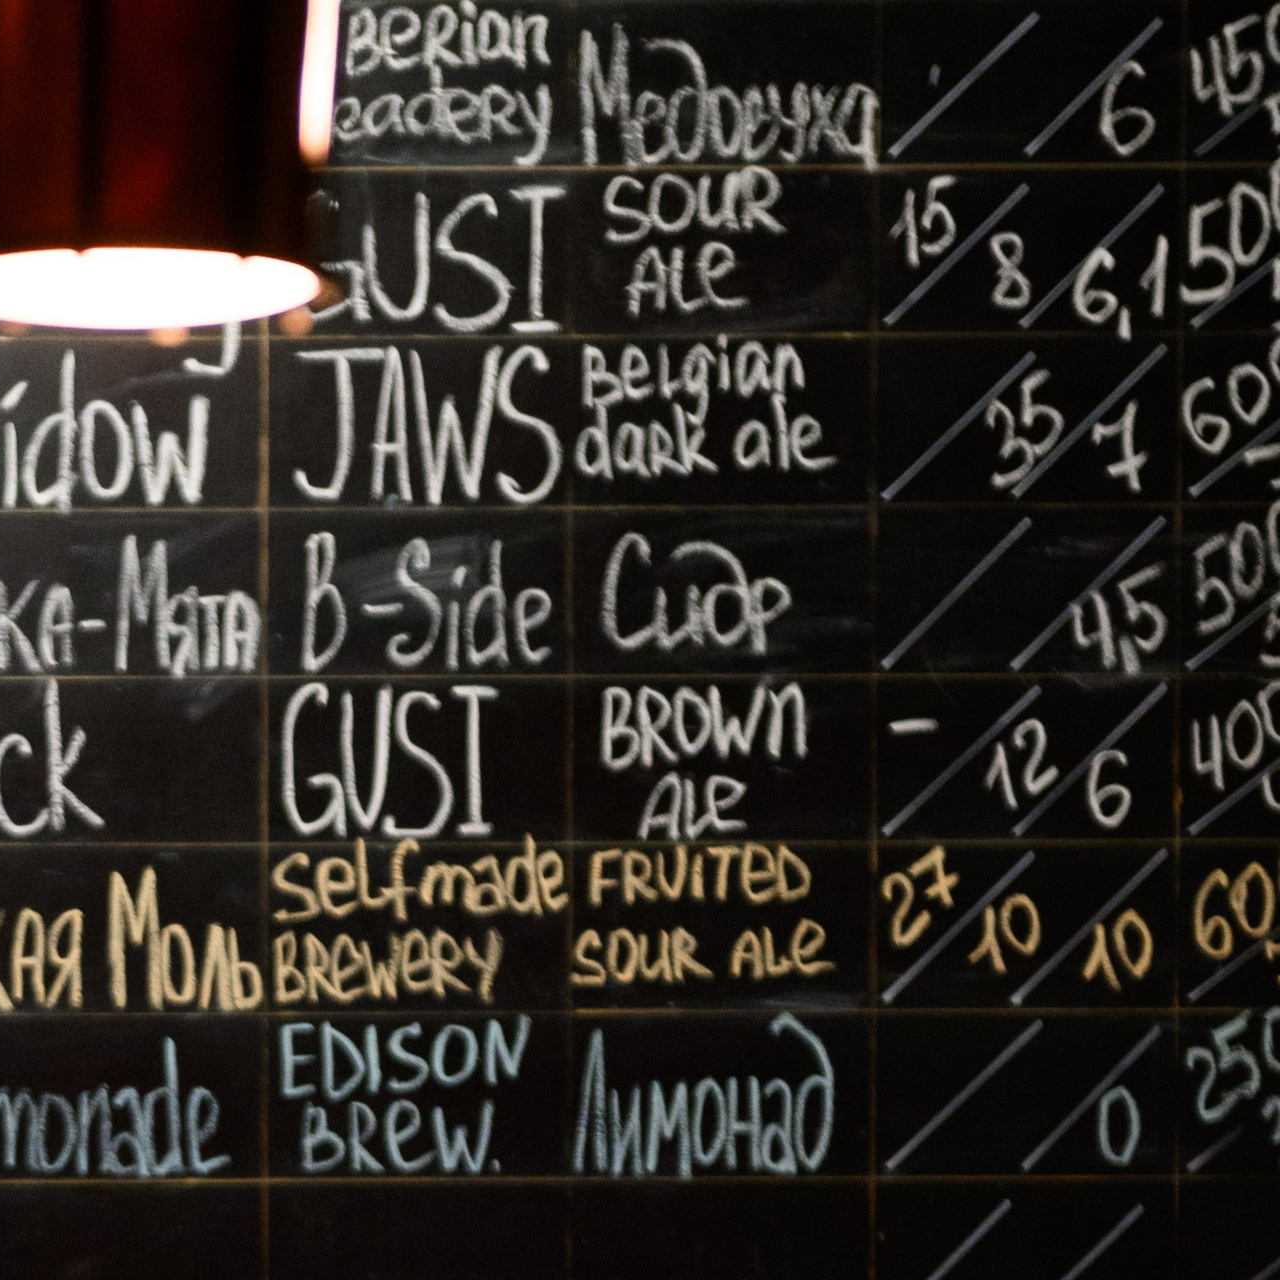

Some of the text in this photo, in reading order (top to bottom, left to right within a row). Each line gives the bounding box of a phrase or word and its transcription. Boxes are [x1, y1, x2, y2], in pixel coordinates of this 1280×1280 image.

[1100, 60, 1156, 156] 6
[889, 175, 957, 268] 15
[991, 231, 1030, 309] 8
[294, 345, 563, 503] JAWS
[733, 394, 838, 472] ale
[986, 370, 1064, 489] 35
[1091, 401, 1148, 493] 7
[282, 681, 499, 838] GUSI
[985, 718, 1059, 809] 12
[1087, 749, 1132, 829] 6
[108, 865, 264, 1011] Моль
[882, 845, 1153, 991] 27 10 10
[1194, 861, 1280, 959] 60
[279, 1013, 532, 1100] EDISON
[1098, 1086, 1140, 1166] 0
